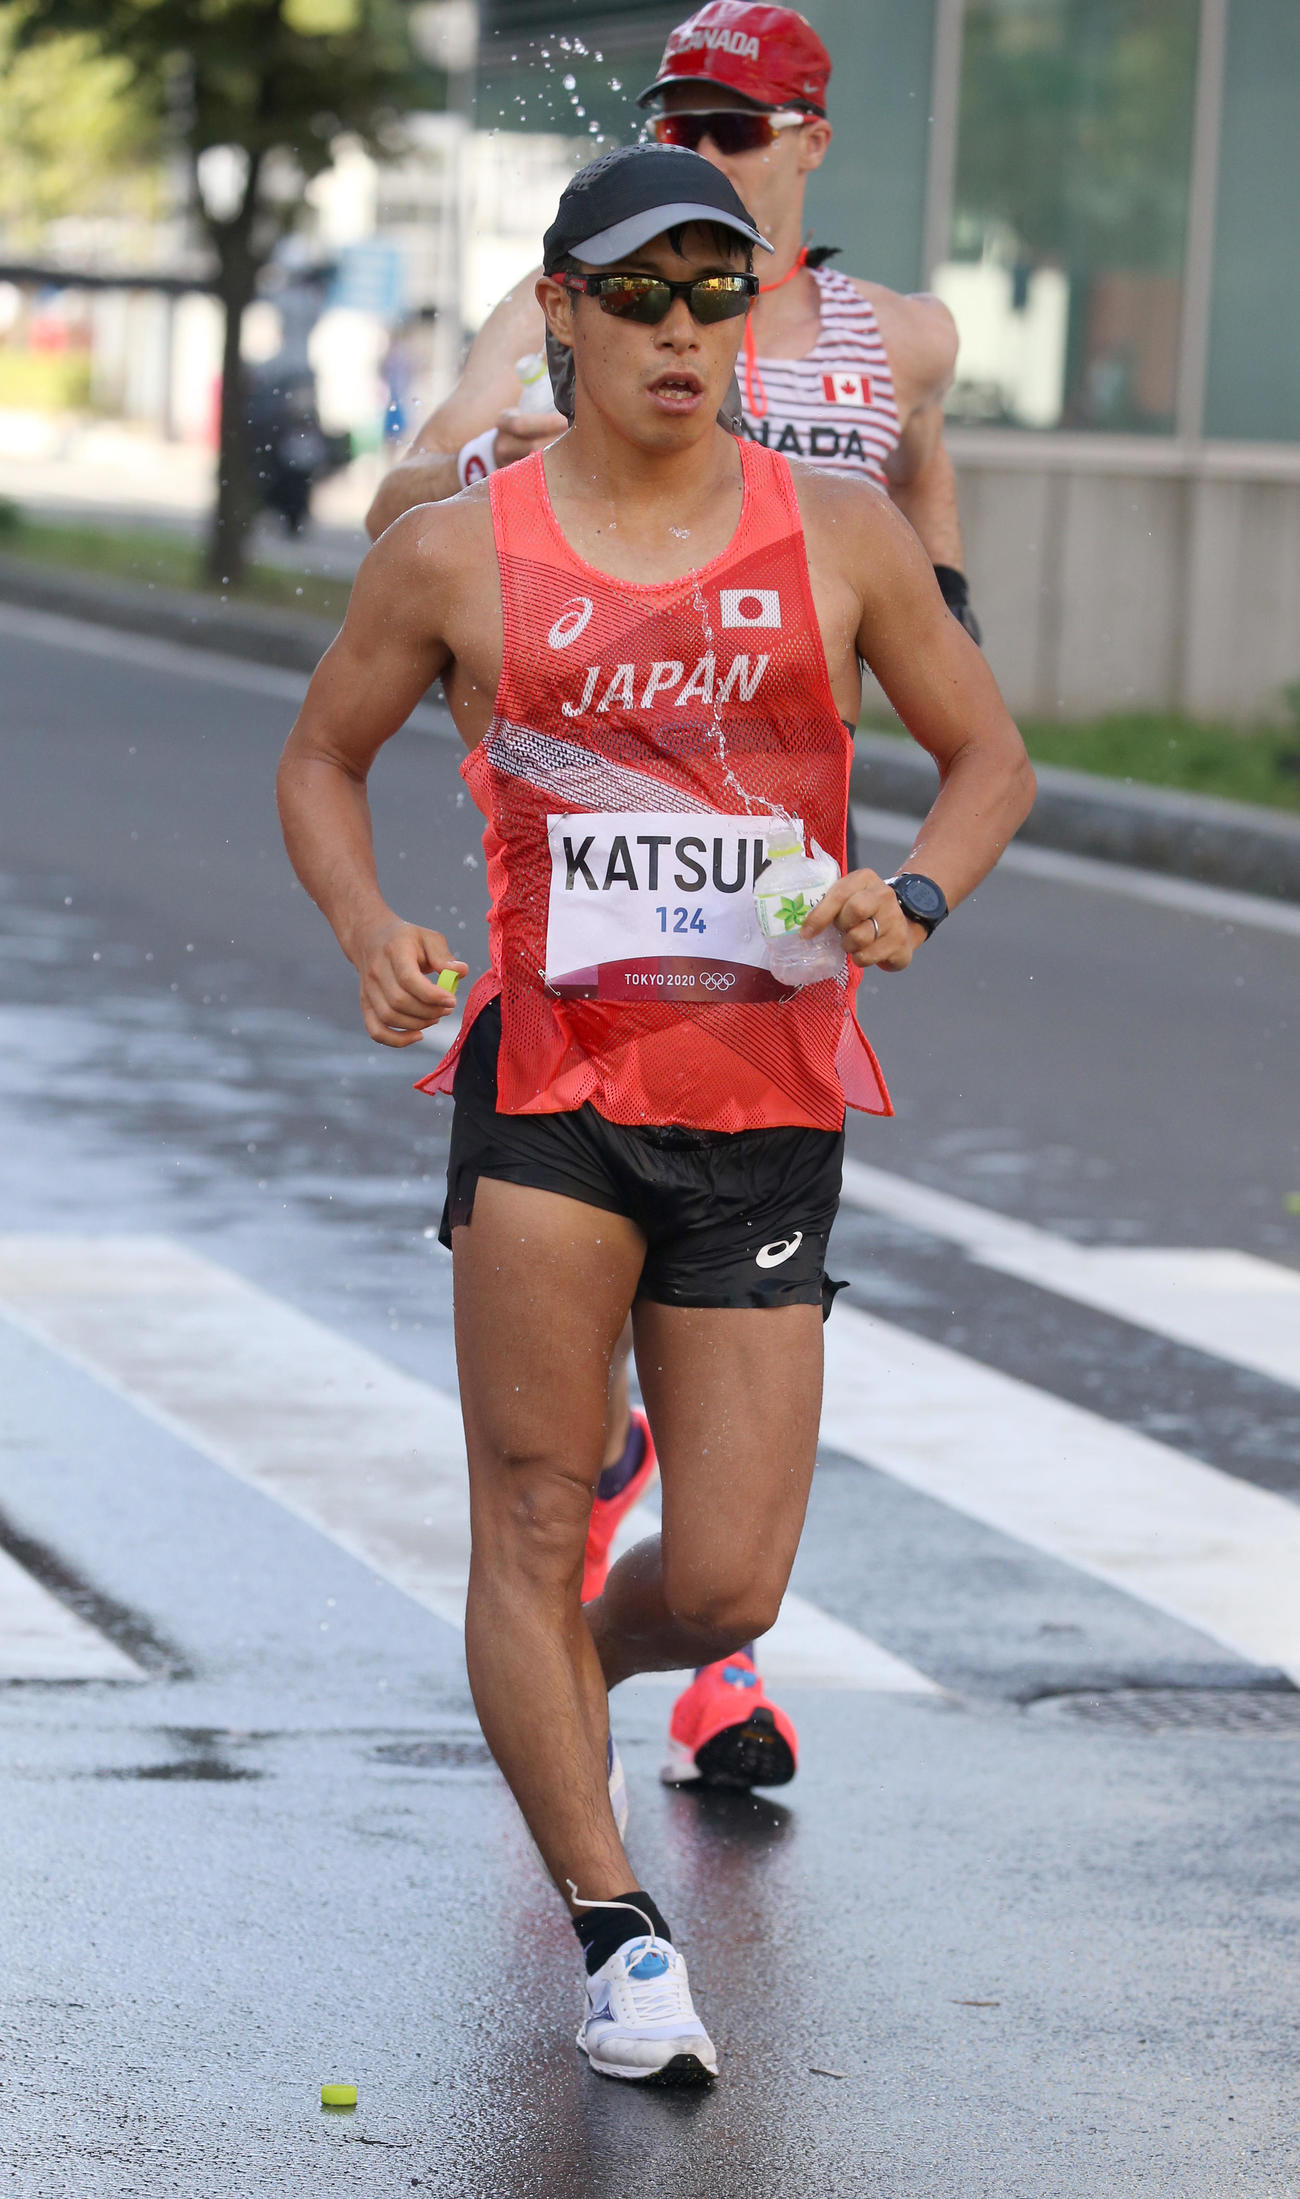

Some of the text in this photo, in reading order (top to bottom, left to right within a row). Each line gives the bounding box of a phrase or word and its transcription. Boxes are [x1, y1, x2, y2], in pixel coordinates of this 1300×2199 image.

[740, 418, 866, 462] NADA
[561, 653, 770, 718] JAPAN
[656, 906, 707, 934] 124
[624, 973, 696, 987] TOKYO 2020
